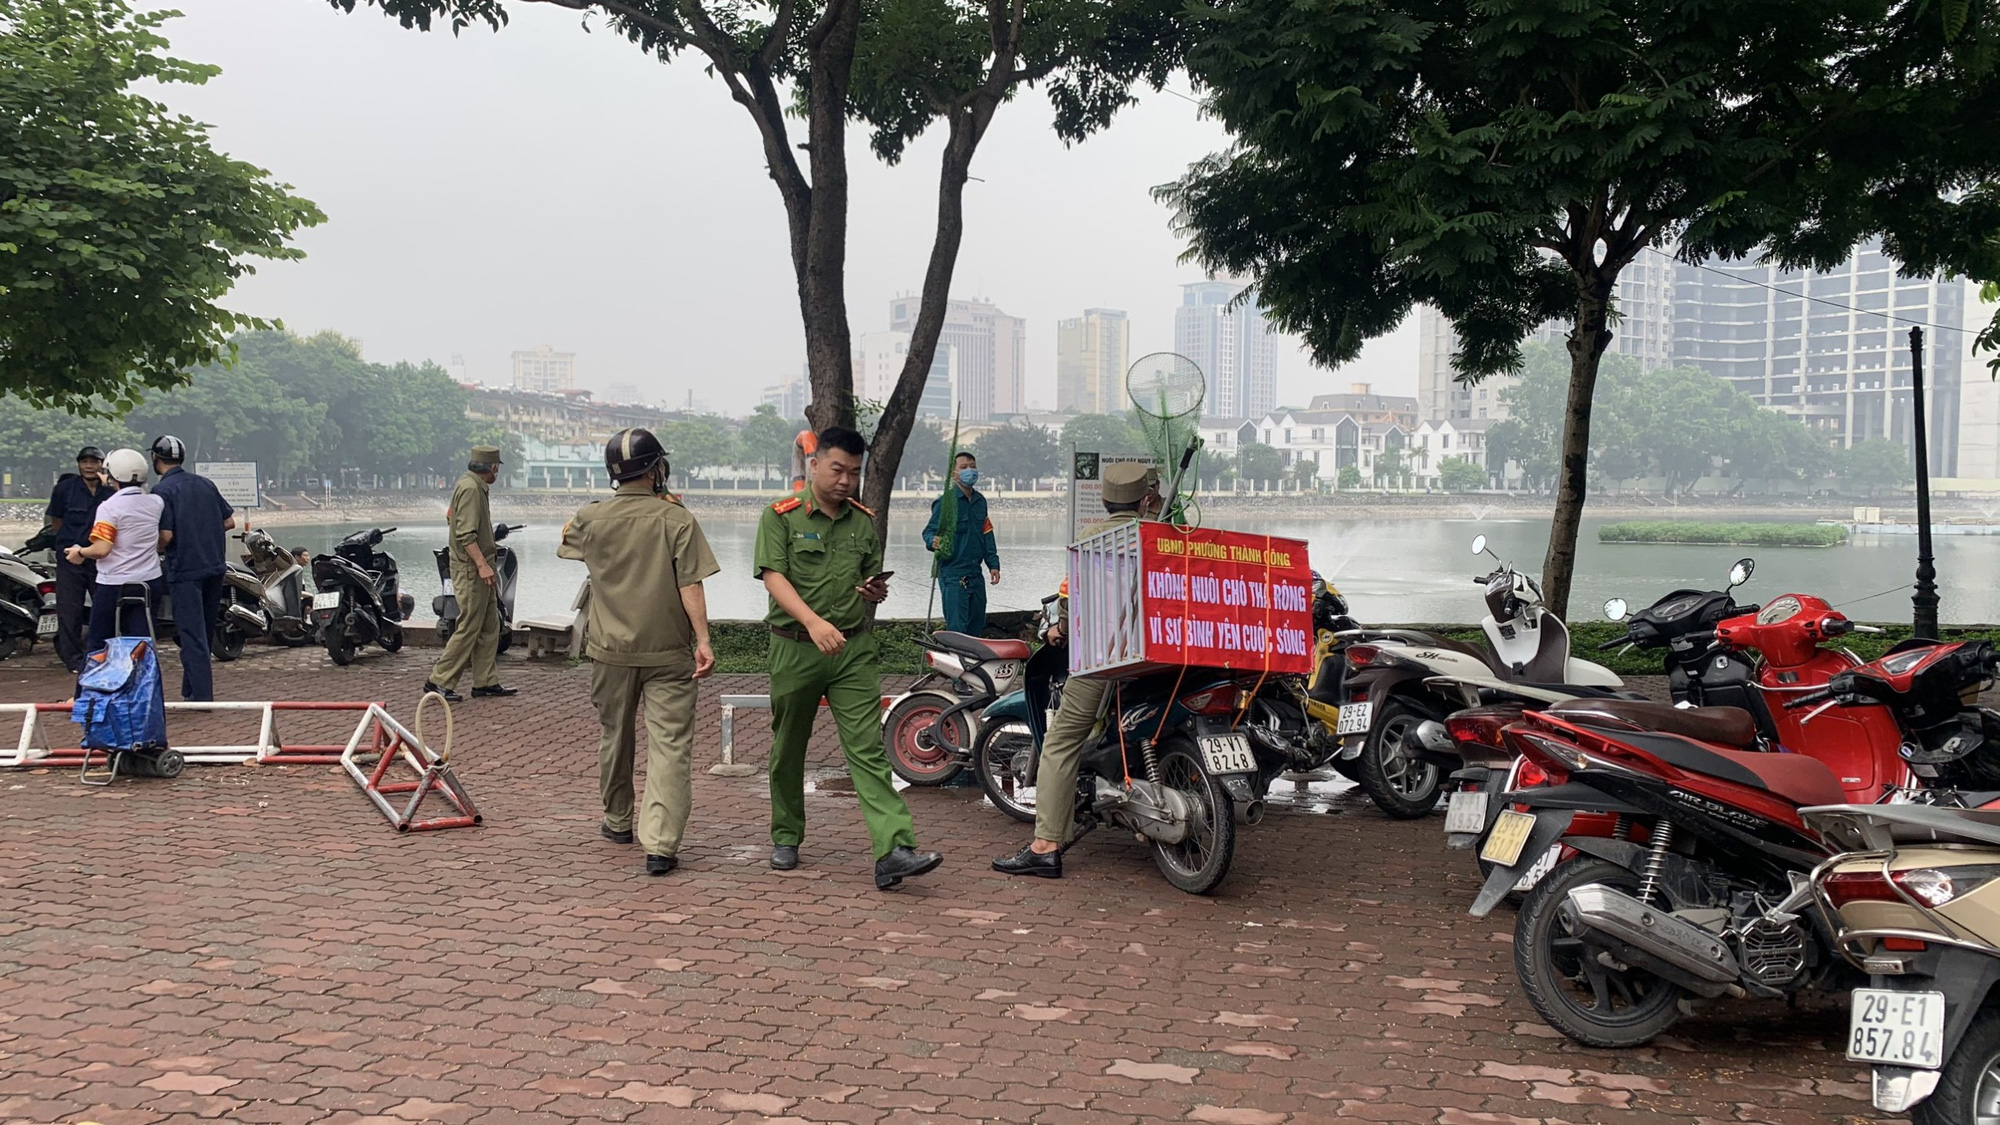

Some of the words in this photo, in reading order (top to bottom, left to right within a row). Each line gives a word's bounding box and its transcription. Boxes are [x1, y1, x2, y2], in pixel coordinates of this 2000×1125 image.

[1157, 538, 1185, 554] UBND
[1187, 540, 1227, 559] PHƯỜNG
[1229, 544, 1262, 563] THÀNH
[1147, 567, 1188, 601] KHÔNG
[1191, 572, 1220, 604] NUÔI
[1222, 575, 1248, 607] CHÓ
[1272, 579, 1307, 612] RÔNG
[1149, 611, 1163, 644] VÌ
[1165, 616, 1183, 652] SỰ
[1187, 614, 1214, 649] BÌNH
[1217, 617, 1242, 650] YÊN
[1275, 619, 1307, 656] SỐNG
[1338, 718, 1368, 733] 072.94
[1342, 704, 1368, 719] 29-E2
[1206, 736, 1243, 753] 29-V1
[1212, 753, 1249, 771] 8248
[1669, 790, 1702, 805] AIR
[1705, 801, 1769, 828] BLADE
[1862, 994, 1928, 1027] 29-E1
[1853, 1027, 1933, 1062] 857.84
